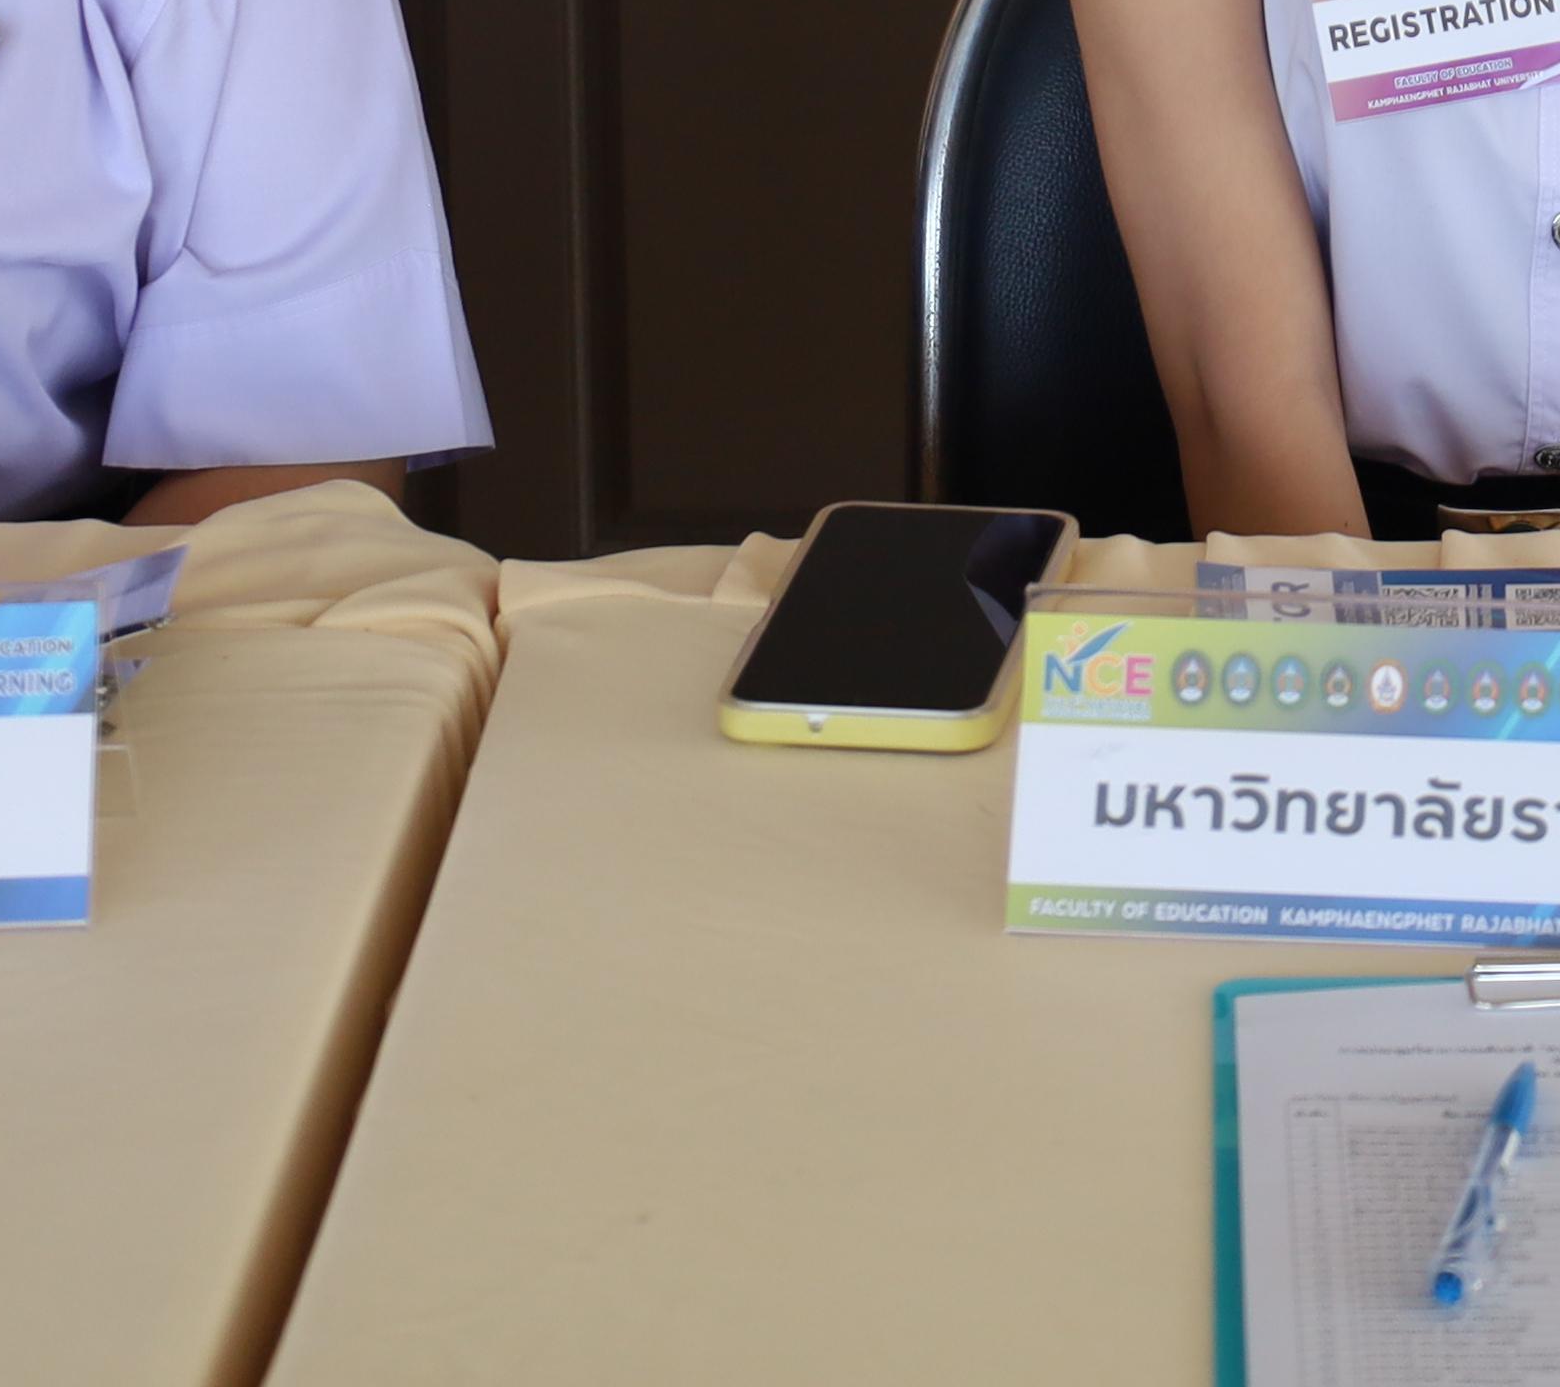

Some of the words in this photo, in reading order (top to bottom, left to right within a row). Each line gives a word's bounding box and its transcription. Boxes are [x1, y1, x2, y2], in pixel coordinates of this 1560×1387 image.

[1395, 71, 1439, 89] FACULTY
[1440, 68, 1455, 81] OF
[1455, 57, 1512, 78] EDUCATION
[1044, 652, 1154, 696] NCE
[1029, 897, 1114, 919] FACULTY
[1121, 900, 1149, 920] OF
[1154, 902, 1268, 925] EDUCATION
[1280, 907, 1454, 932] KAMPHAENGPHET
